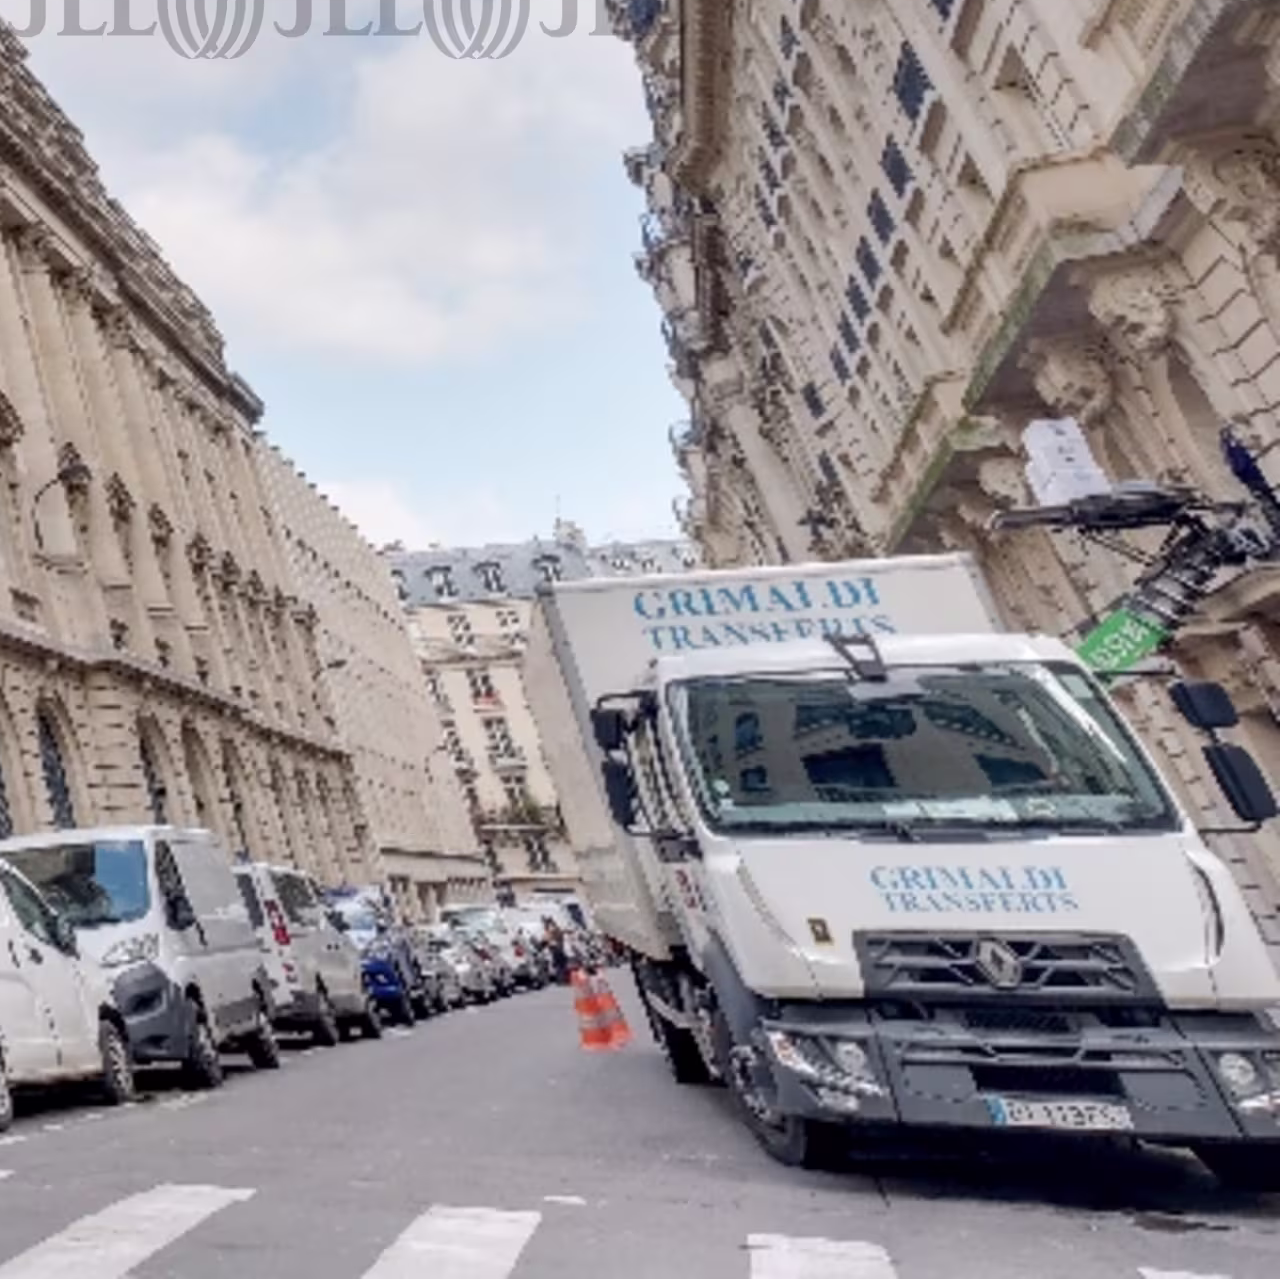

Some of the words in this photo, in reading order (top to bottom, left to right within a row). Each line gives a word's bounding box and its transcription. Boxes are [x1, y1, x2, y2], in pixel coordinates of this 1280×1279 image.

[633, 577, 880, 619] GRIMALDI
[870, 865, 1068, 890] GRIMALDI
[880, 891, 1080, 913] TRANSFERTS
